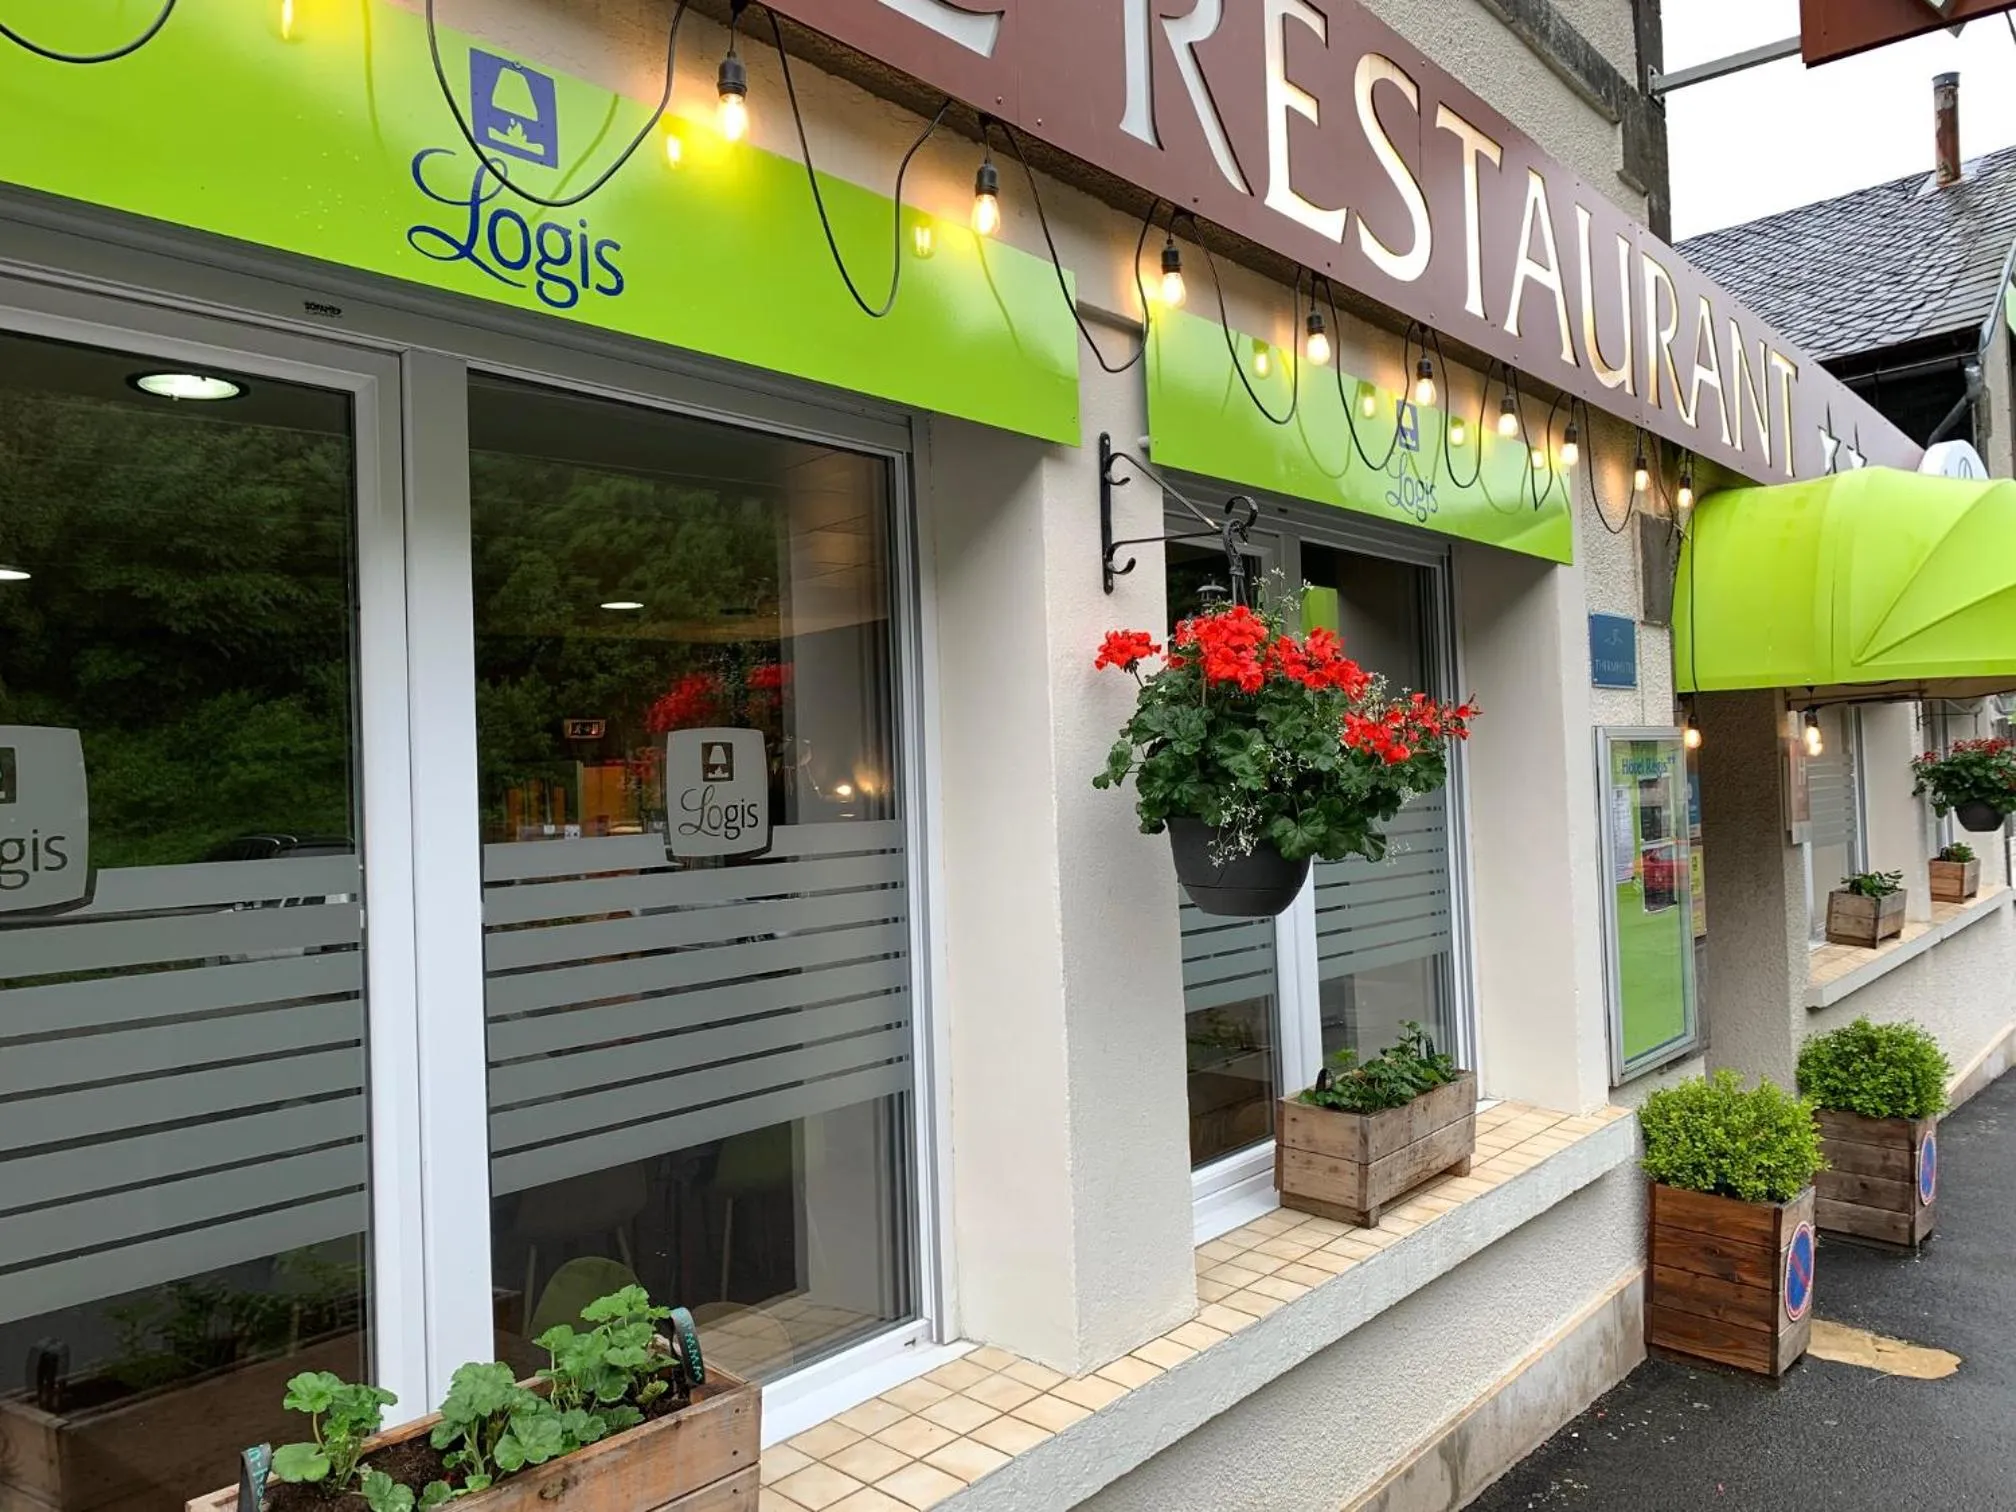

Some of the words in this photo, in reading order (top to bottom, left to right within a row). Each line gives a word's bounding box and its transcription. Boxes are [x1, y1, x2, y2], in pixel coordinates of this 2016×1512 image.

[407, 147, 625, 309] Logis
[1119, 0, 1798, 478] RESTAURANT
[1385, 451, 1439, 523] Logis
[678, 785, 759, 841] Logis
